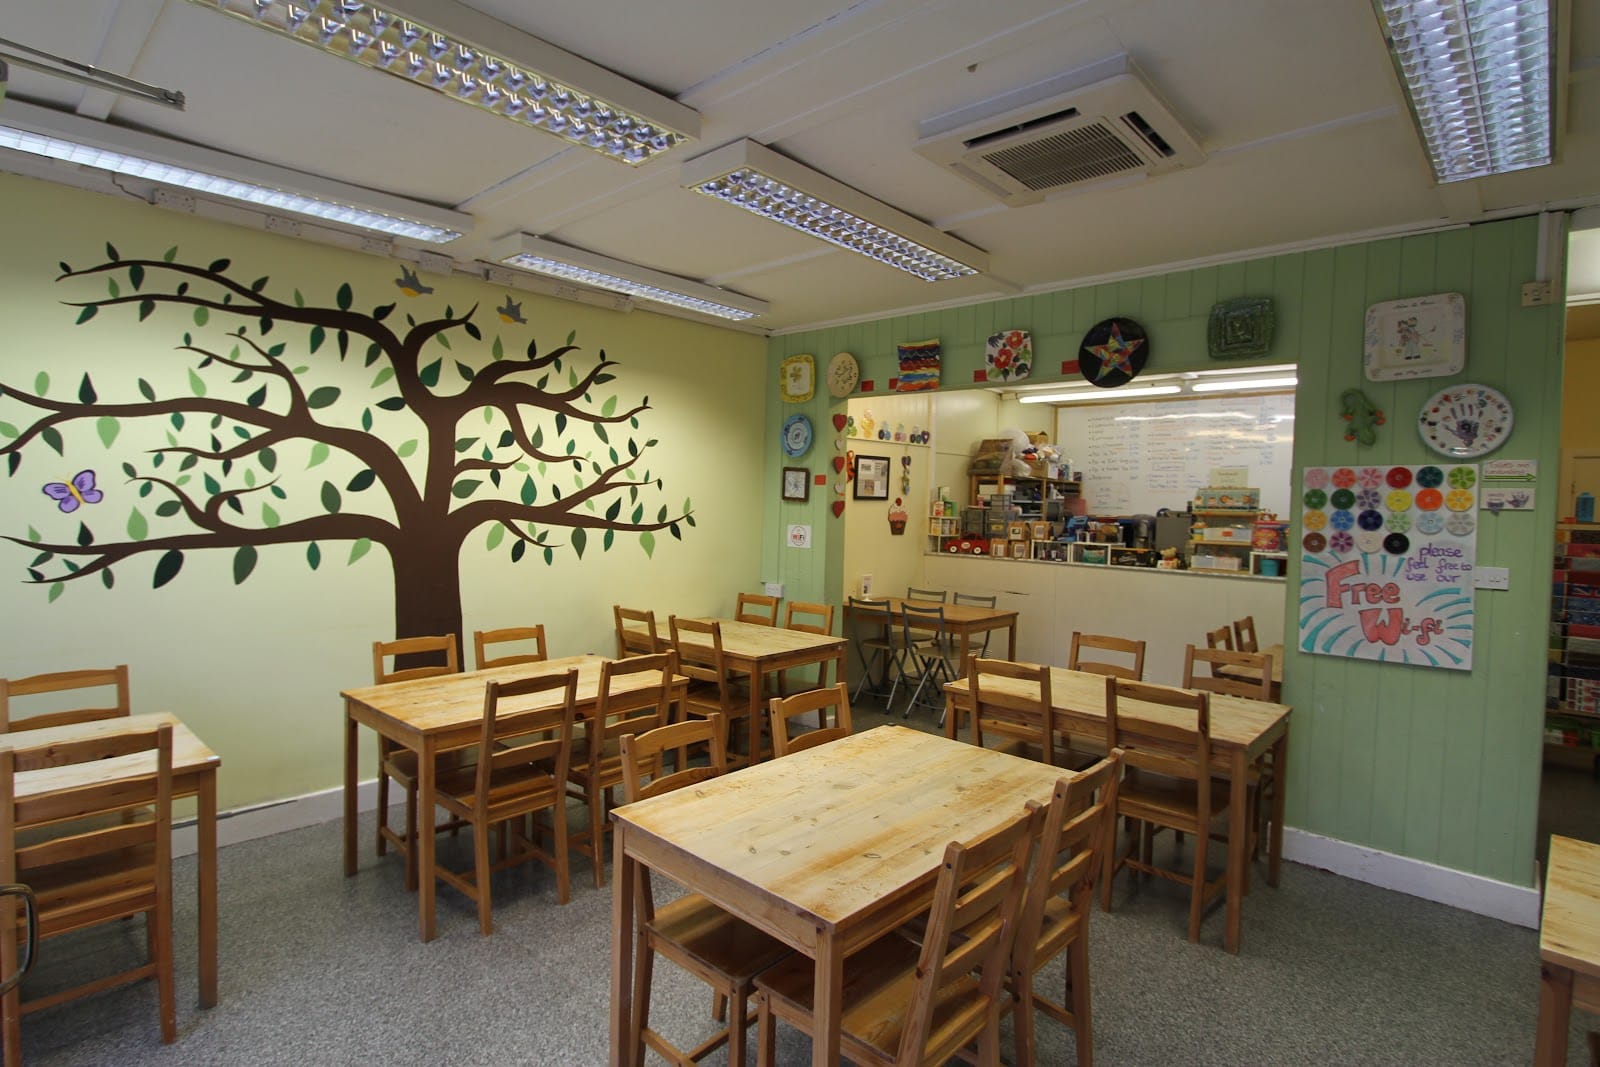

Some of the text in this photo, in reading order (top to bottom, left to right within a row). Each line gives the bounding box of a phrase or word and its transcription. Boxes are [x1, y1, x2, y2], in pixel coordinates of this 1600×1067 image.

[1419, 542, 1463, 560] please
[1405, 556, 1429, 572] feel
[1435, 558, 1459, 574] free
[1326, 560, 1401, 608] Free
[1406, 573, 1460, 582] use our
[1359, 607, 1444, 646] Wi-fi
